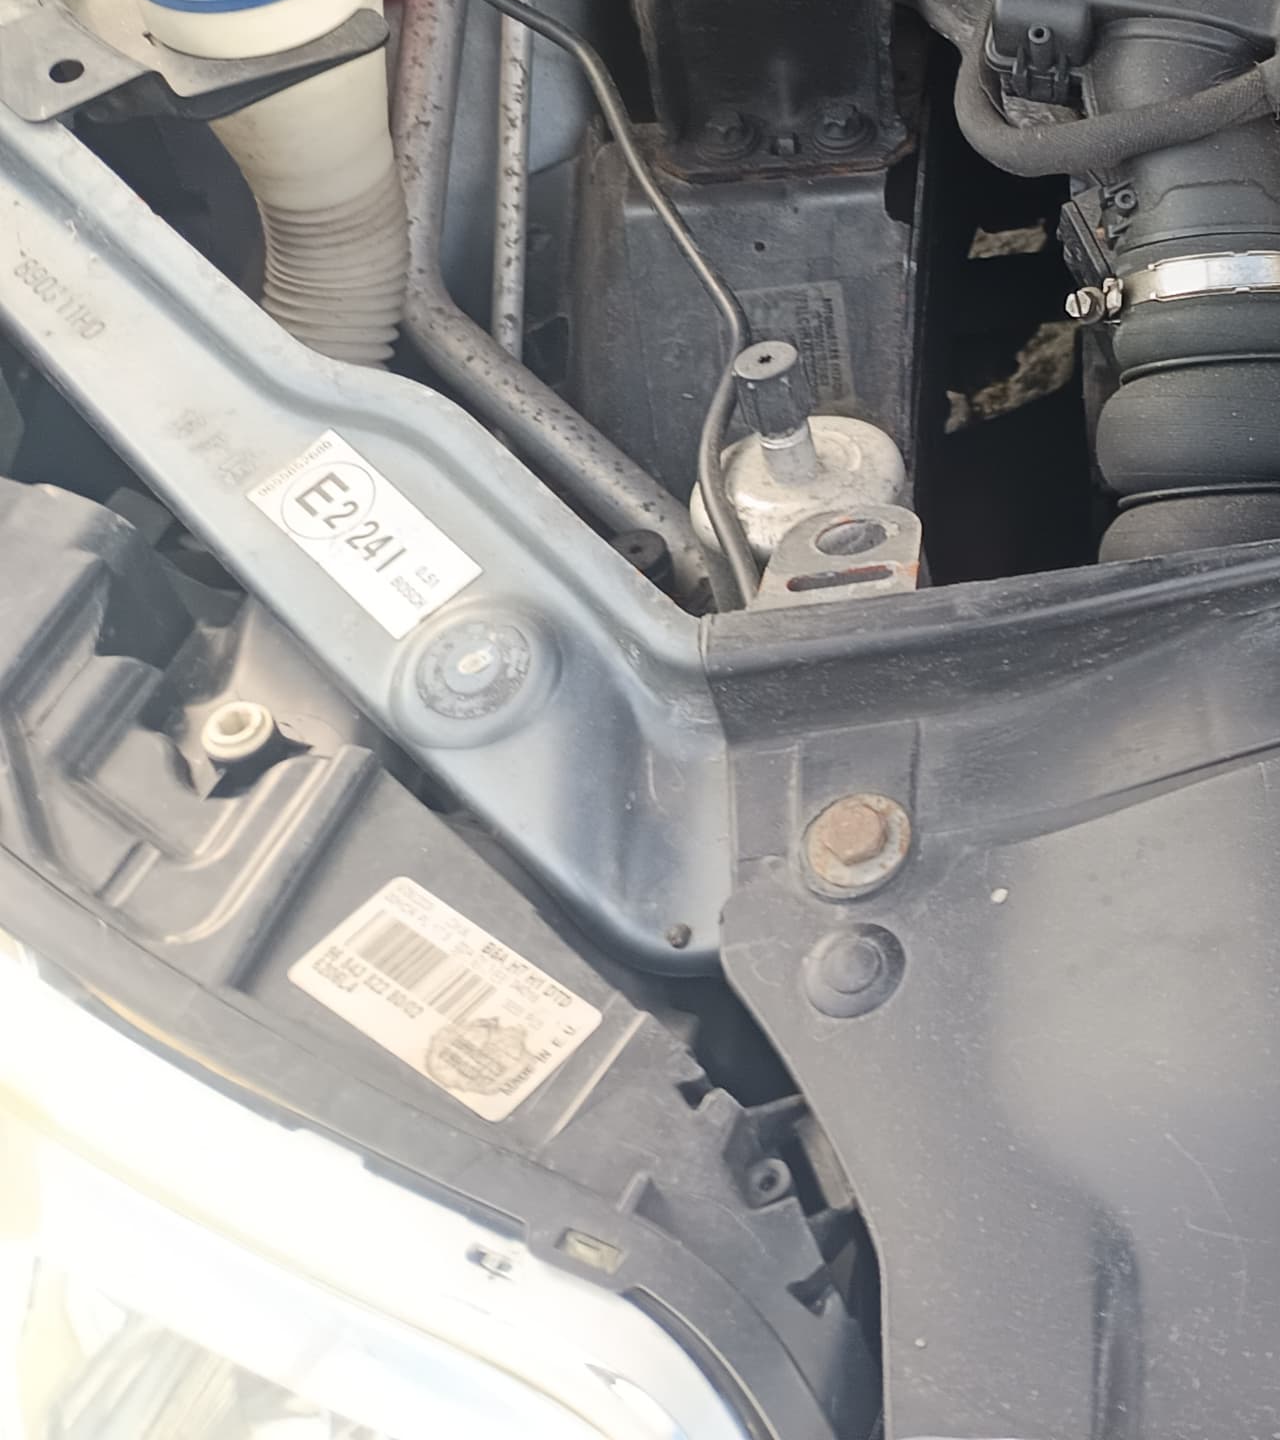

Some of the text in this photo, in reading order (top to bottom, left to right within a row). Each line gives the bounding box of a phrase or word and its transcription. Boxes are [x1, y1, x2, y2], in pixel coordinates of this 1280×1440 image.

[389, 574, 427, 610] BOSCH
[500, 1065, 533, 1096] MADE
[536, 1049, 552, 1064] IN
